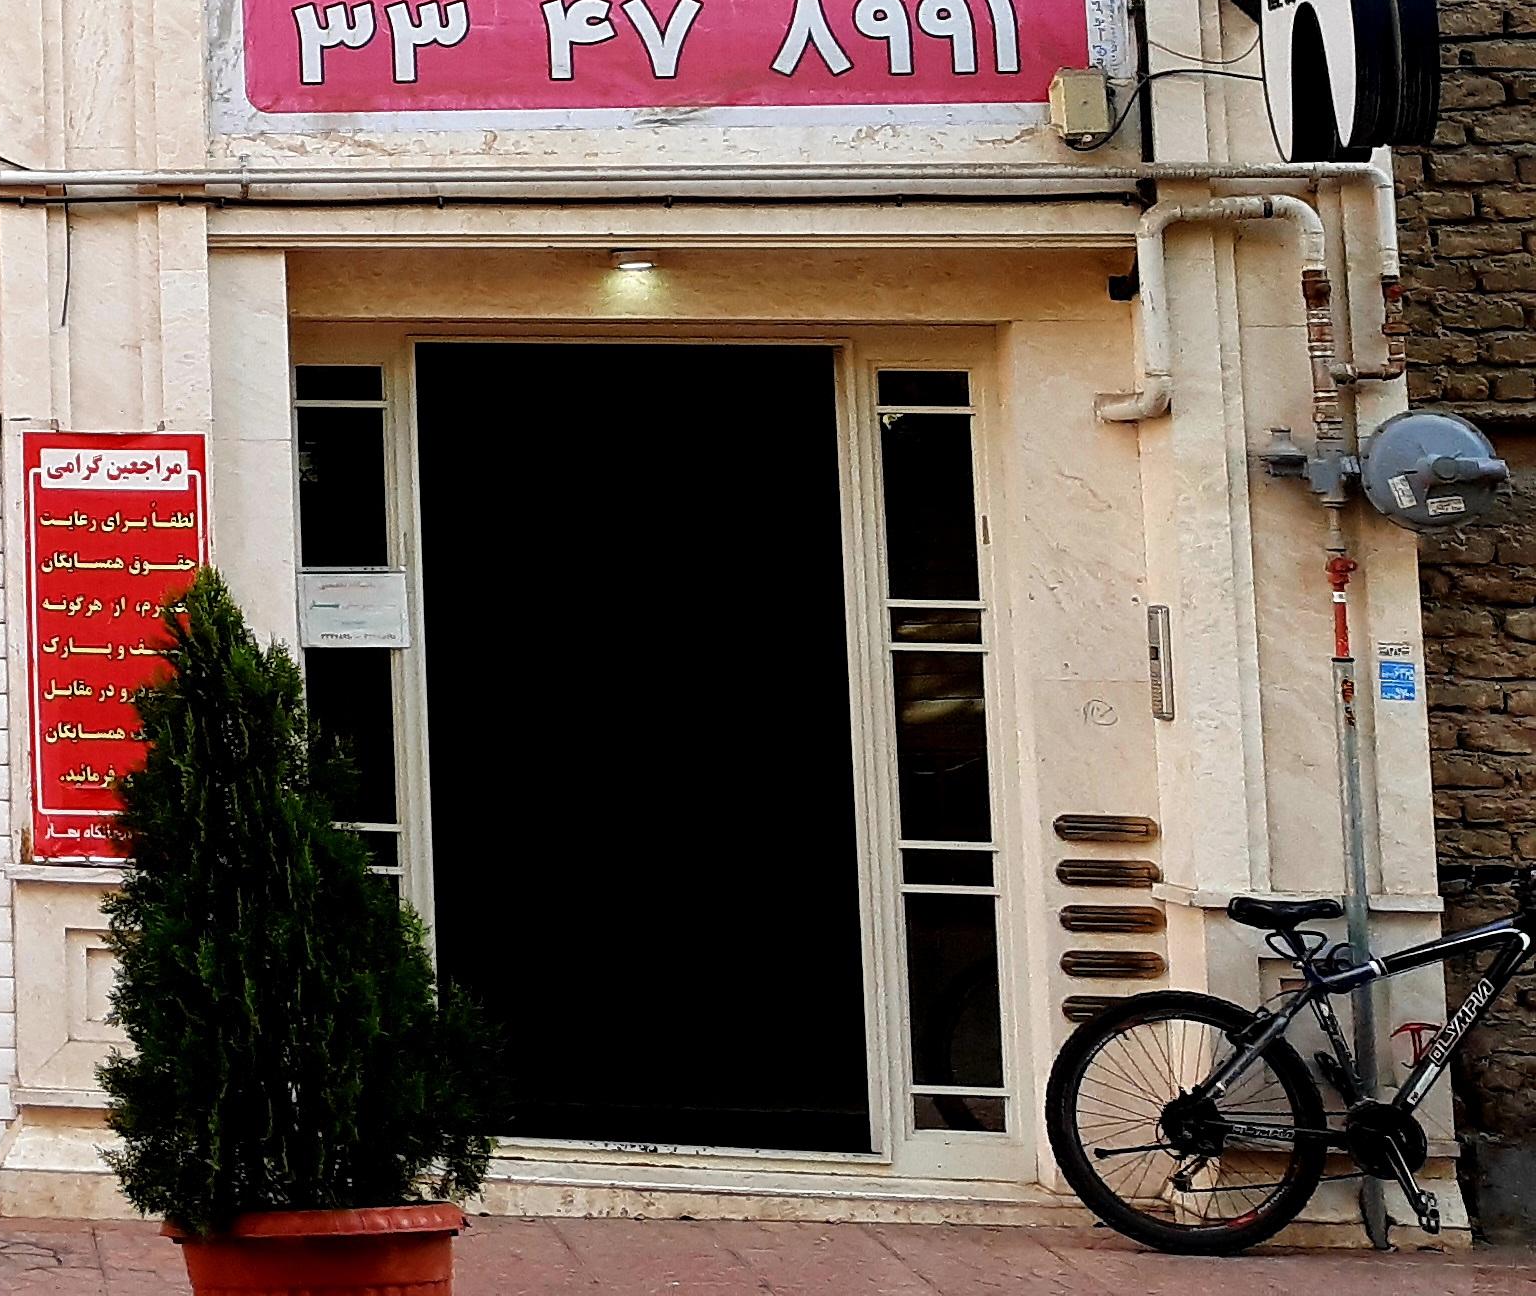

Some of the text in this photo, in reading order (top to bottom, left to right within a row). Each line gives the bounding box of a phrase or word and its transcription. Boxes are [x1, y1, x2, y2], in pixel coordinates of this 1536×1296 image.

[47, 453, 182, 481] مراجعین گرامی
[40, 511, 96, 531] رعایت
[101, 511, 148, 533] برای
[41, 552, 197, 575] حقوق همسایگان
[113, 596, 126, 616] از
[42, 636, 112, 660] پارک
[116, 644, 125, 660] و
[44, 679, 93, 699] مقابل
[98, 683, 115, 701] در
[45, 722, 126, 743] همسایگان
[1428, 977, 1495, 1067] OLYMPIA
